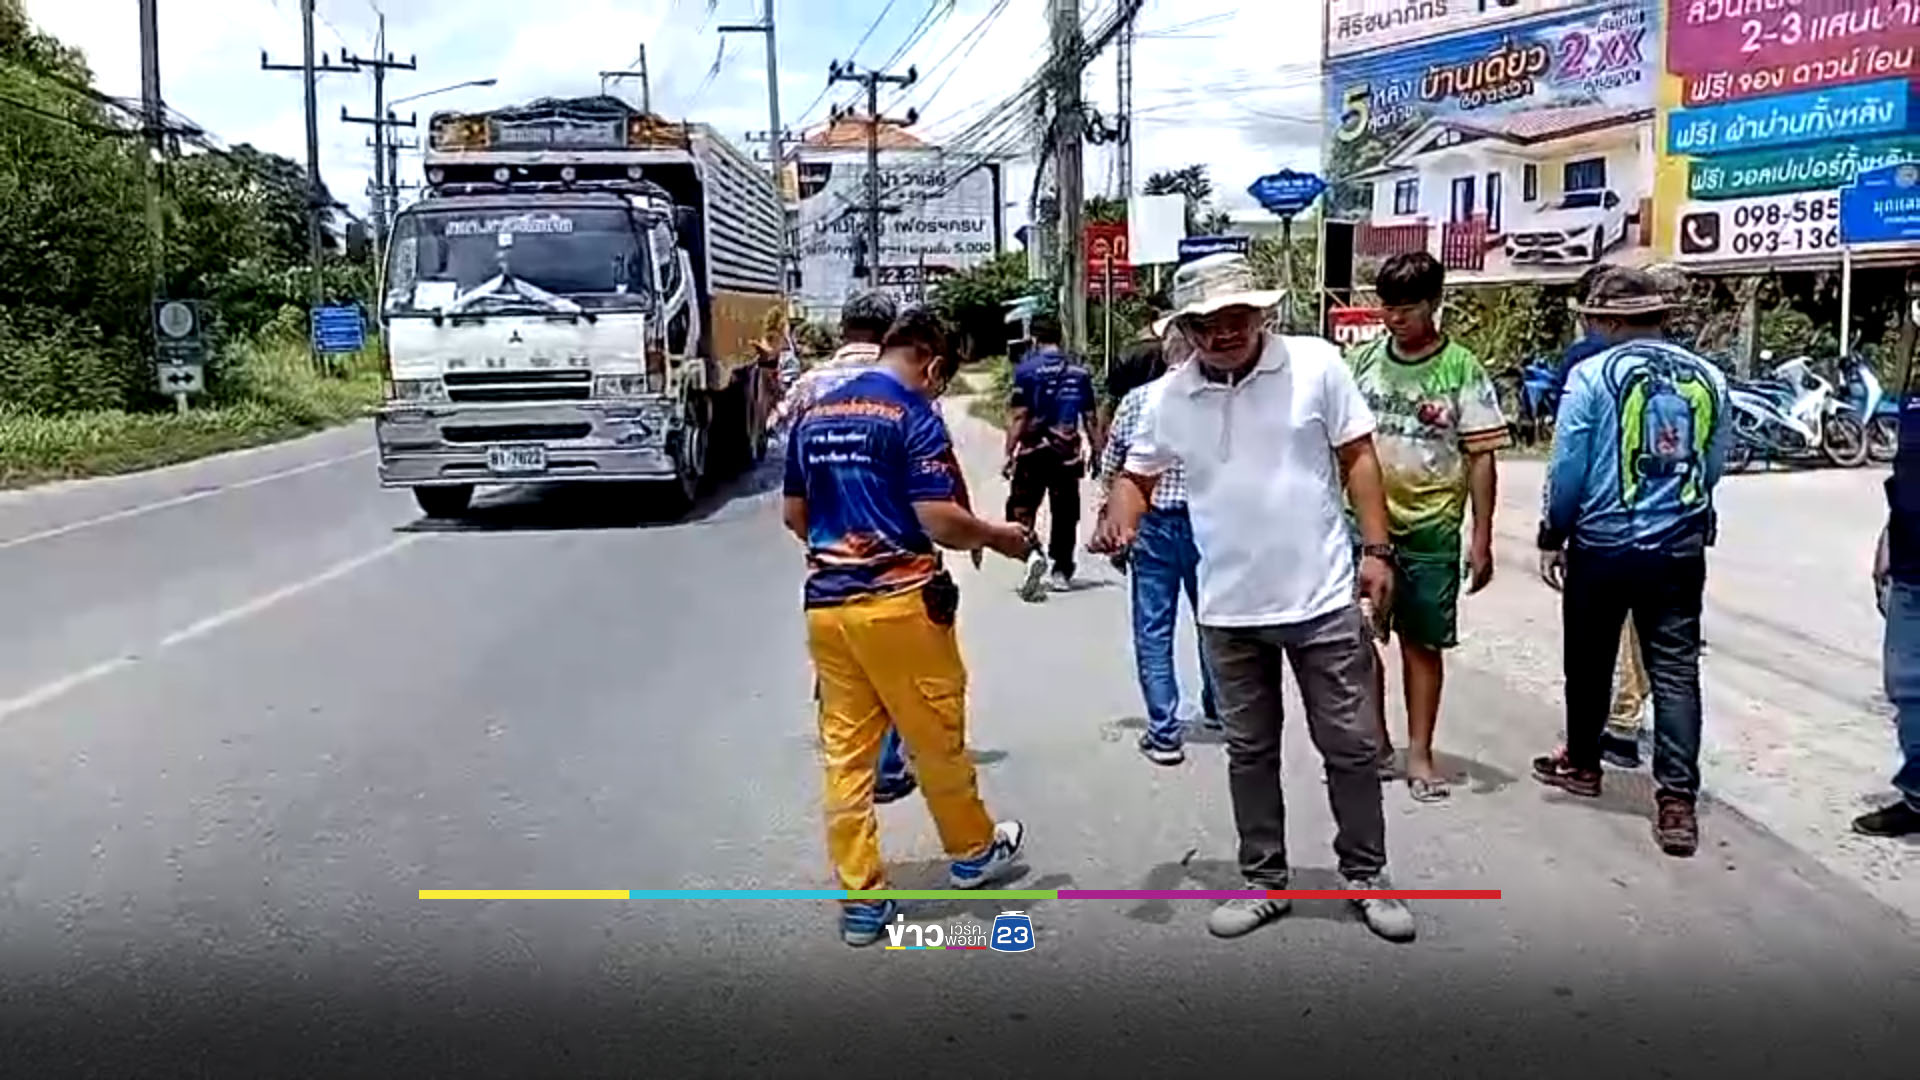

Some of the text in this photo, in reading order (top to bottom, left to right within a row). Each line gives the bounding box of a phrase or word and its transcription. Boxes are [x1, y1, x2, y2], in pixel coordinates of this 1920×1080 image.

[1420, 34, 1546, 100] บ้านเดี่ยว
[1691, 71, 1733, 101] ฟรี!
[1738, 68, 1784, 92] จอง
[1793, 48, 1858, 83] ดาวน์
[1337, 82, 1369, 142] 5
[1725, 97, 1895, 142] ผ้าม่านทั้งหลัง
